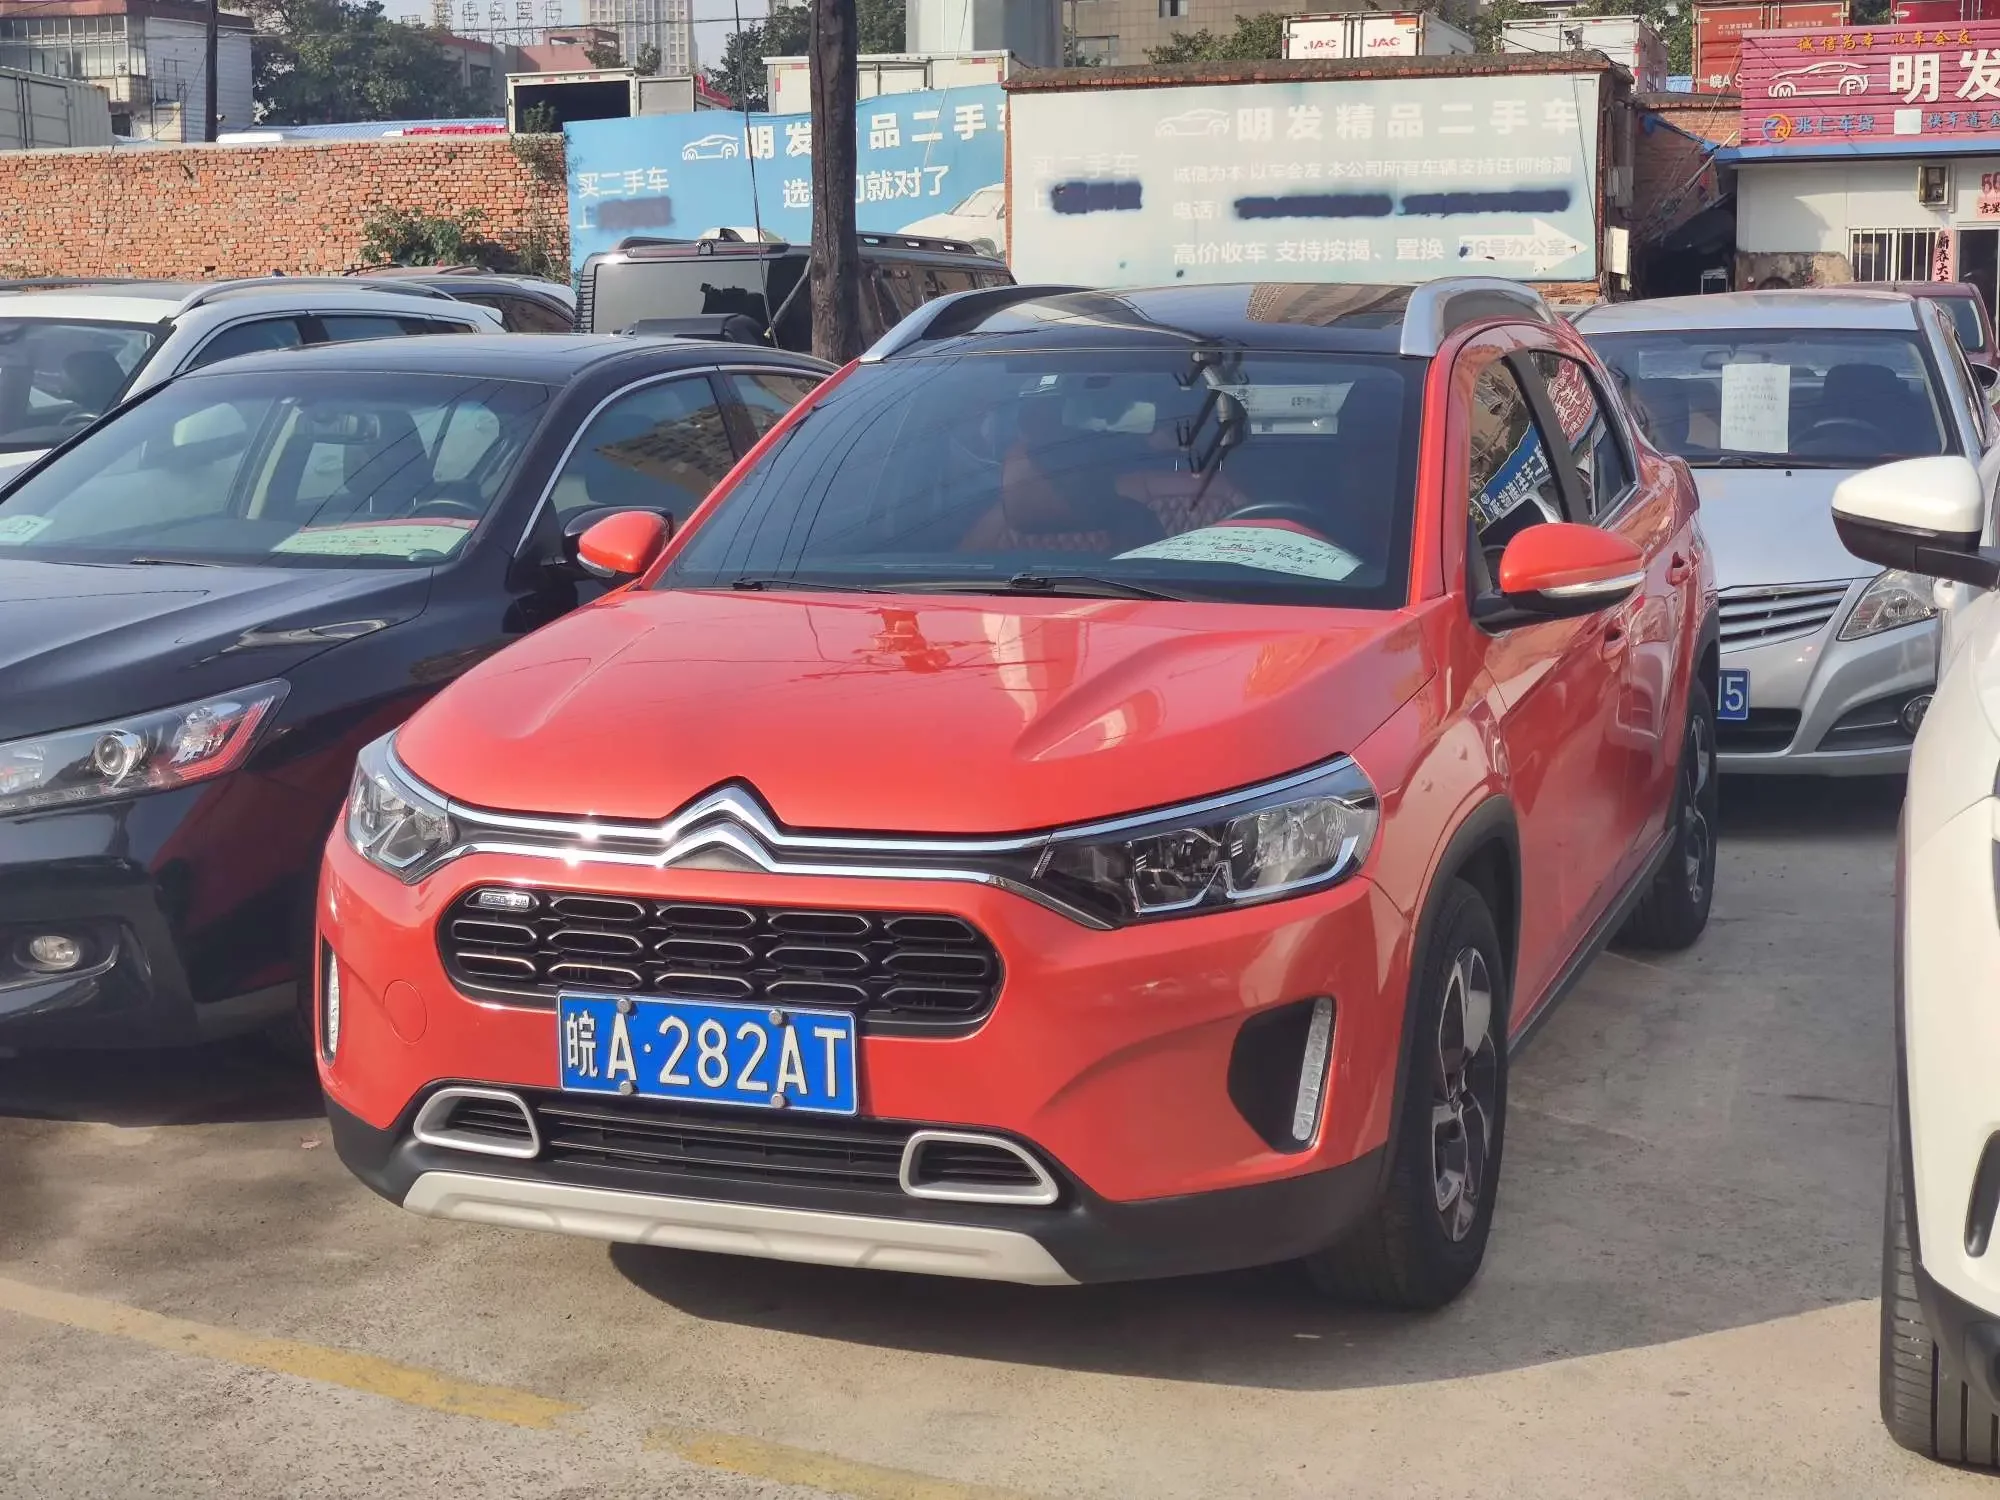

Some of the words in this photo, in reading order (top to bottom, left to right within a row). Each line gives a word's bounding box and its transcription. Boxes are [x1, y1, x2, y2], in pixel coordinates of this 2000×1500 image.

[1304, 39, 1337, 50] JAC
[1367, 37, 1400, 47] JAC
[1889, 48, 2000, 104] 明发
[744, 104, 1006, 161] 明发品二手
[1237, 97, 1579, 142] 明发精品二手车
[1796, 114, 1875, 134] 兆仁车贷
[578, 166, 669, 199] 买二手车
[782, 165, 949, 208] 选就对了
[1172, 241, 1268, 266] 高价收车
[566, 1009, 847, 1098] 皖A·282AT
